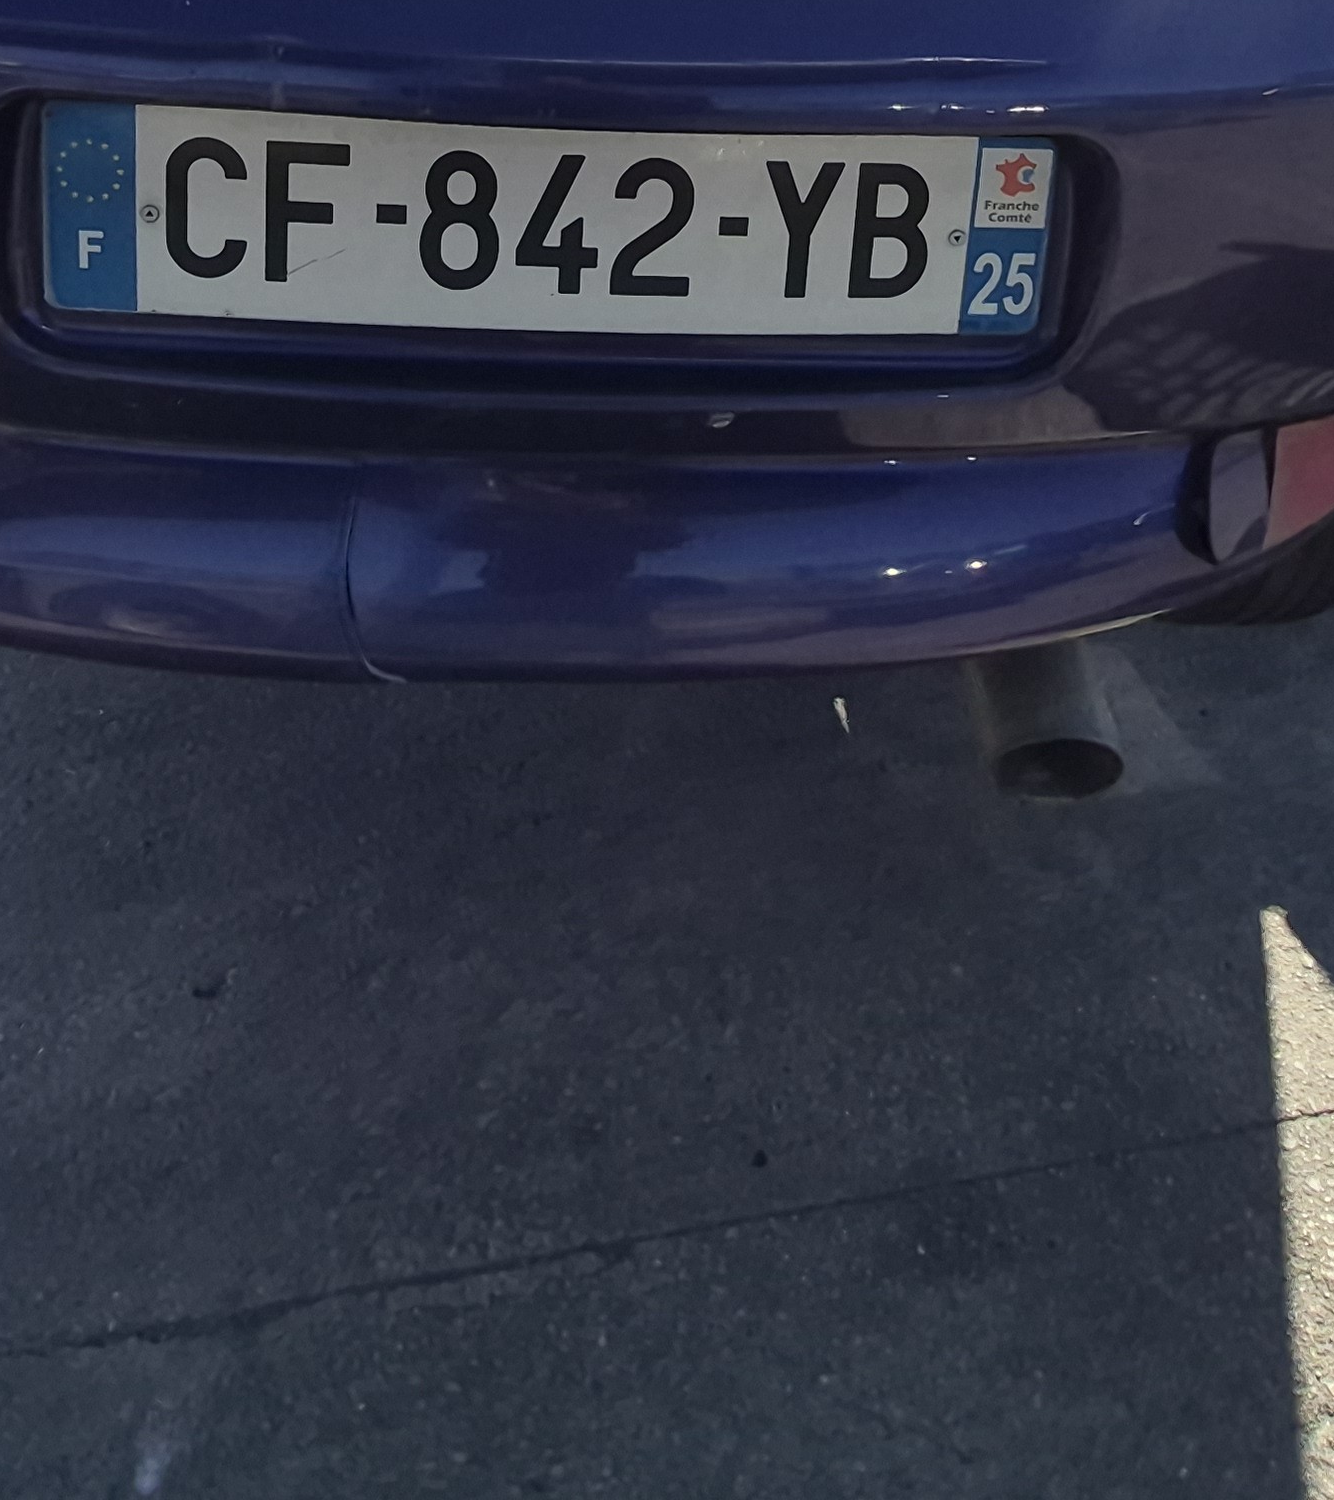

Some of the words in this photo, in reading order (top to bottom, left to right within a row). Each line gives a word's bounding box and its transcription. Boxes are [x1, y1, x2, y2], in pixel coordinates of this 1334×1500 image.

[164, 136, 931, 299] CF-842-YB
[984, 200, 1040, 212] Franche
[988, 212, 1033, 224] Comté
[78, 230, 104, 270] F
[967, 252, 1037, 315] 25
